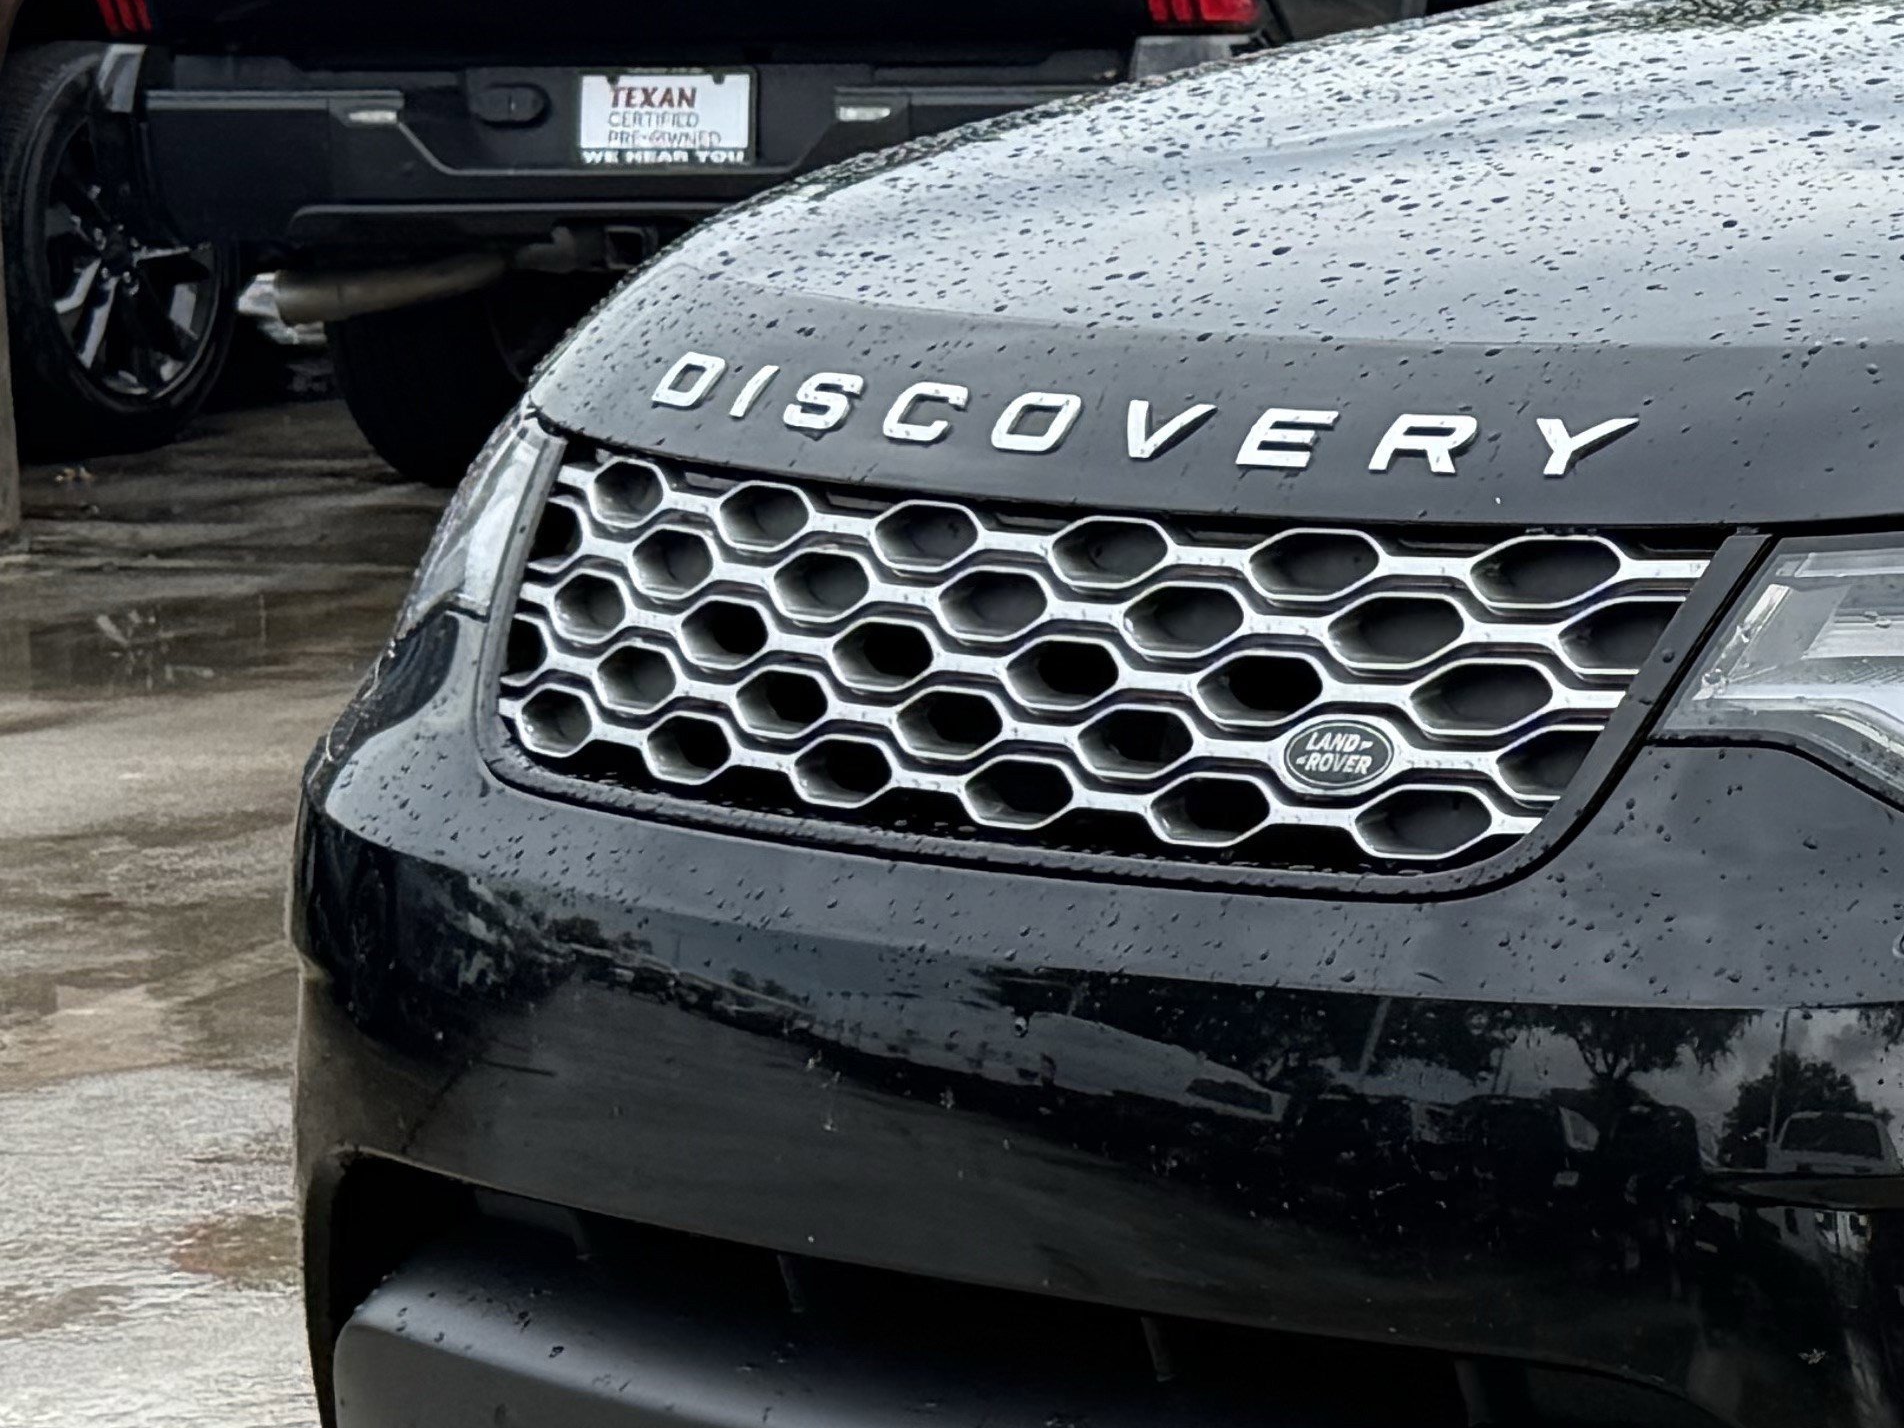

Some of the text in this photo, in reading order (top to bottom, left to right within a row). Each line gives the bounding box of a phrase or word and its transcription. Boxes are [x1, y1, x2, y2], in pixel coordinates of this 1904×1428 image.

[611, 87, 697, 108] TEXAN
[608, 111, 699, 128] CERTIFIED
[582, 150, 618, 163] WE
[696, 150, 744, 163] YOU
[652, 351, 1640, 476] DISCOVERY
[1306, 732, 1361, 751] LAND
[1305, 753, 1372, 774] ROVER
